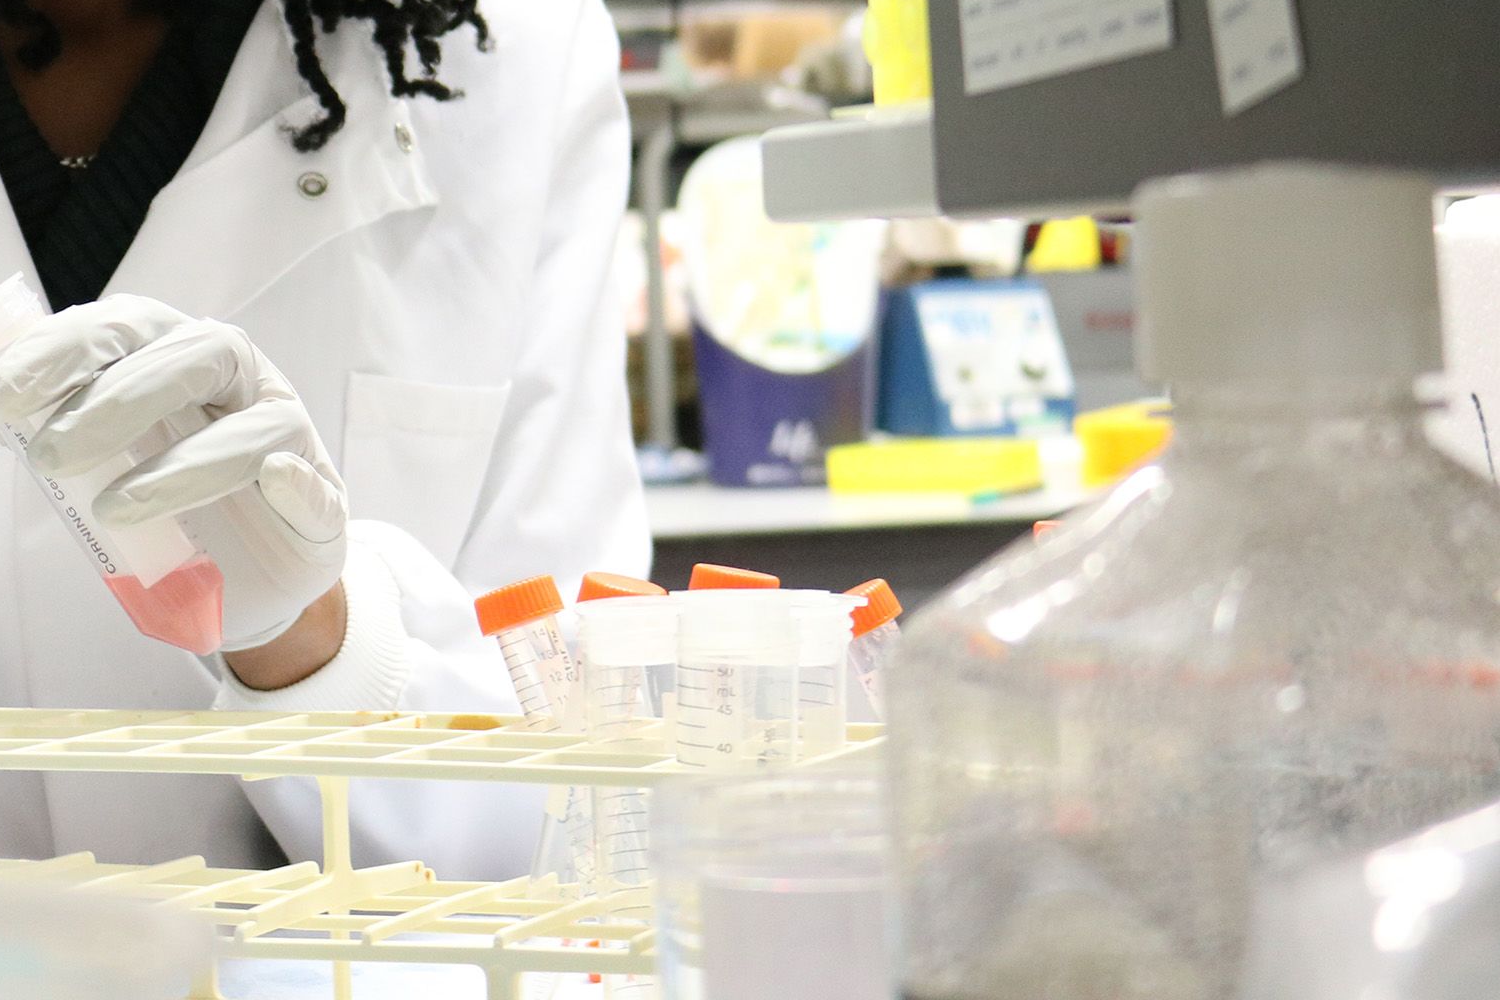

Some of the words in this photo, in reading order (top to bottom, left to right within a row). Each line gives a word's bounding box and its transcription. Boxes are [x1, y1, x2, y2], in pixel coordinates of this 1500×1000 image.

[65, 506, 117, 575] CORNING
[716, 704, 733, 716] 45
[716, 743, 733, 754] 40
